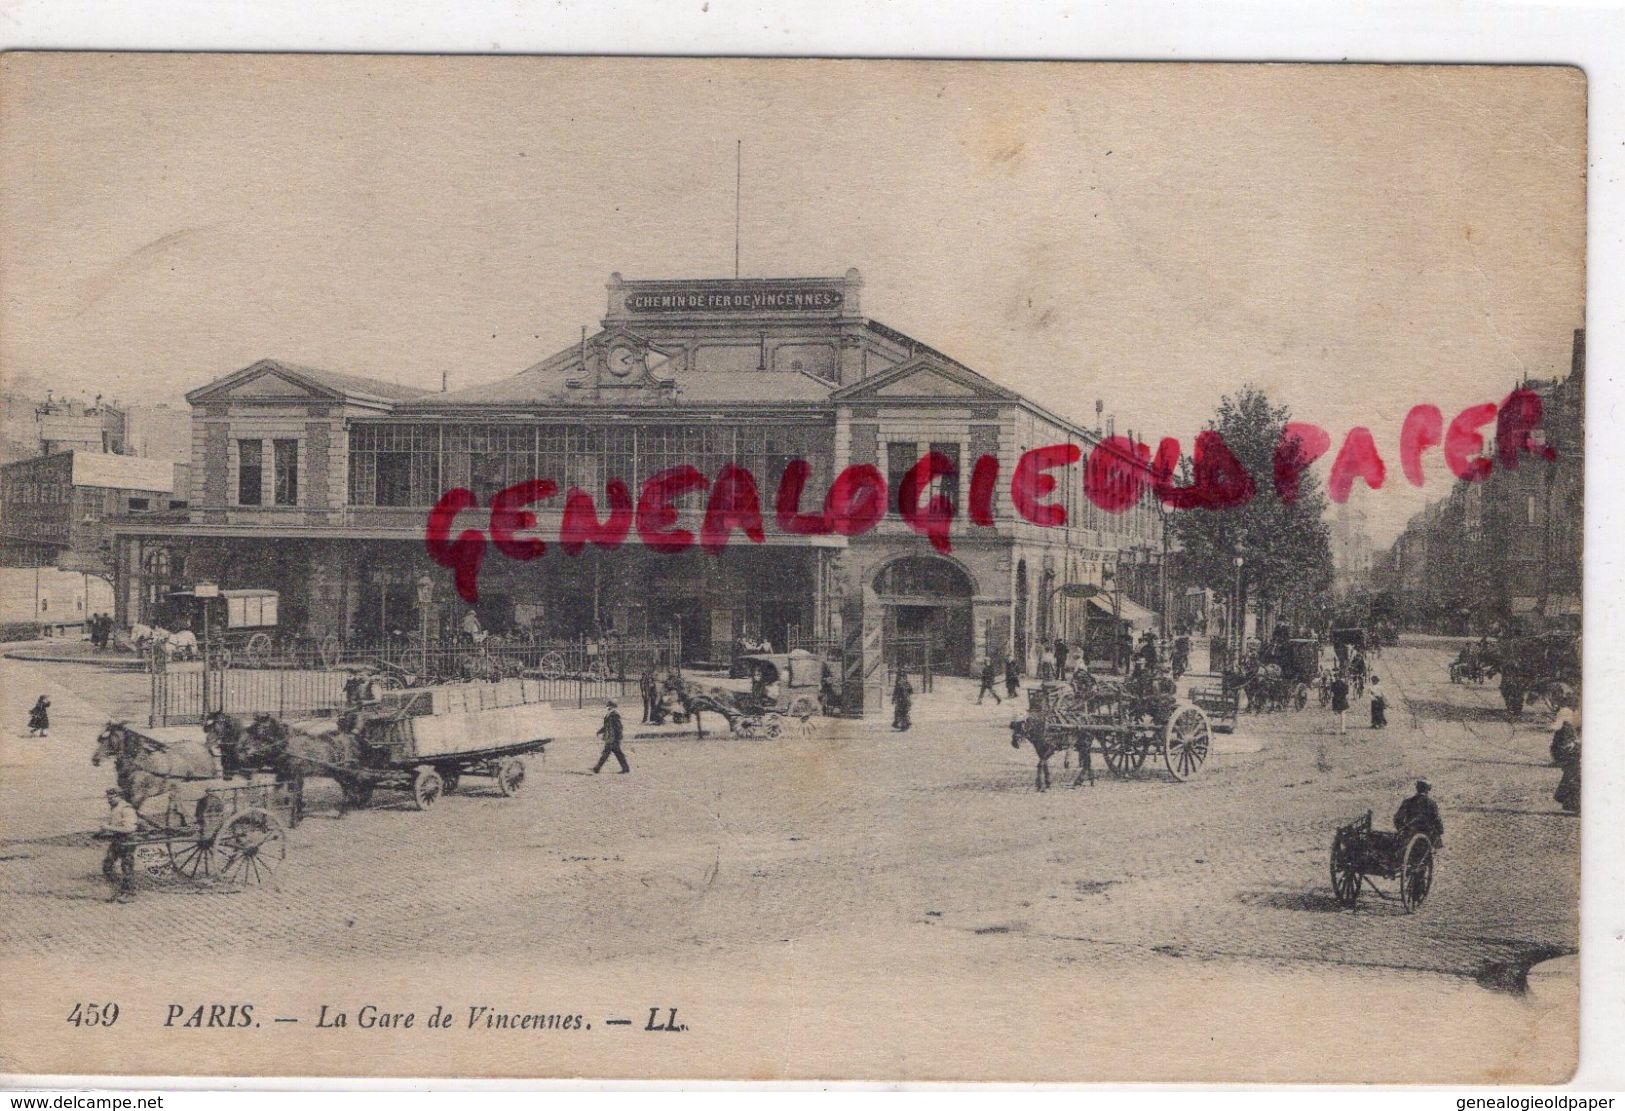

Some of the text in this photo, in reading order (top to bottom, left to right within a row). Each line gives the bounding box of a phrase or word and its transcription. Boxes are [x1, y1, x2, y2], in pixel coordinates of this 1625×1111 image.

[635, 292, 832, 308] CHEMIN DE FER DE VINCENNES
[67, 1003, 119, 1027] 459
[164, 1005, 261, 1028] PARIS.
[316, 1005, 347, 1028] La
[358, 1005, 415, 1029] Gare
[427, 1006, 453, 1029] de
[468, 1007, 592, 1030] Vincennes.
